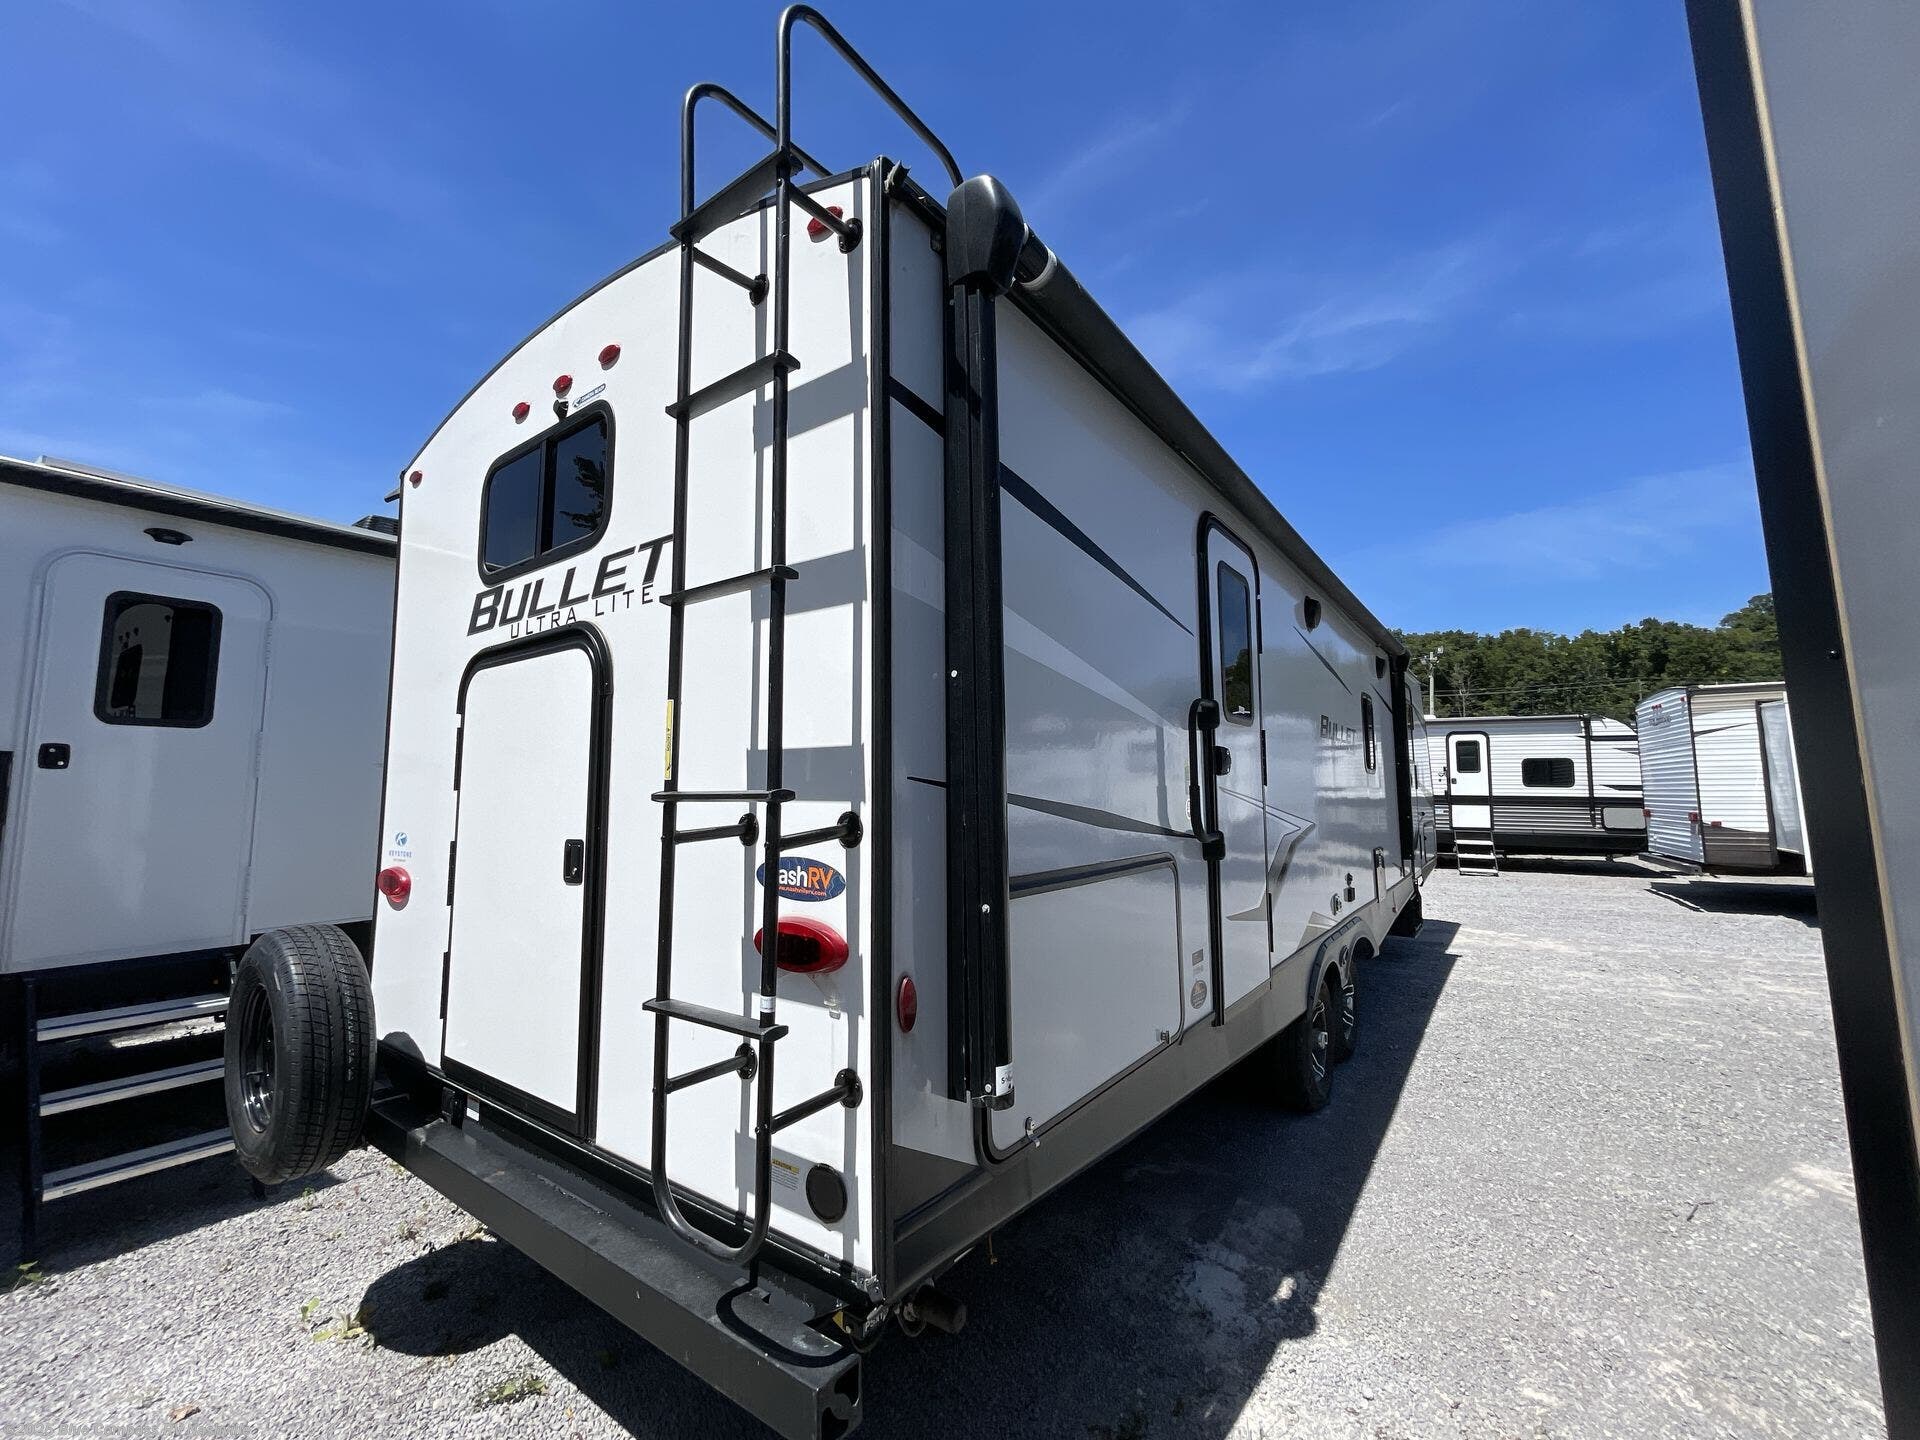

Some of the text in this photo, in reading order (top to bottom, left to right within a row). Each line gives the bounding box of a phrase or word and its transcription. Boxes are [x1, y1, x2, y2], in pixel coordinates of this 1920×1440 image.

[467, 534, 673, 636] BULLET
[510, 584, 654, 639] ULTRA LITE
[779, 865, 834, 889] ashRV
